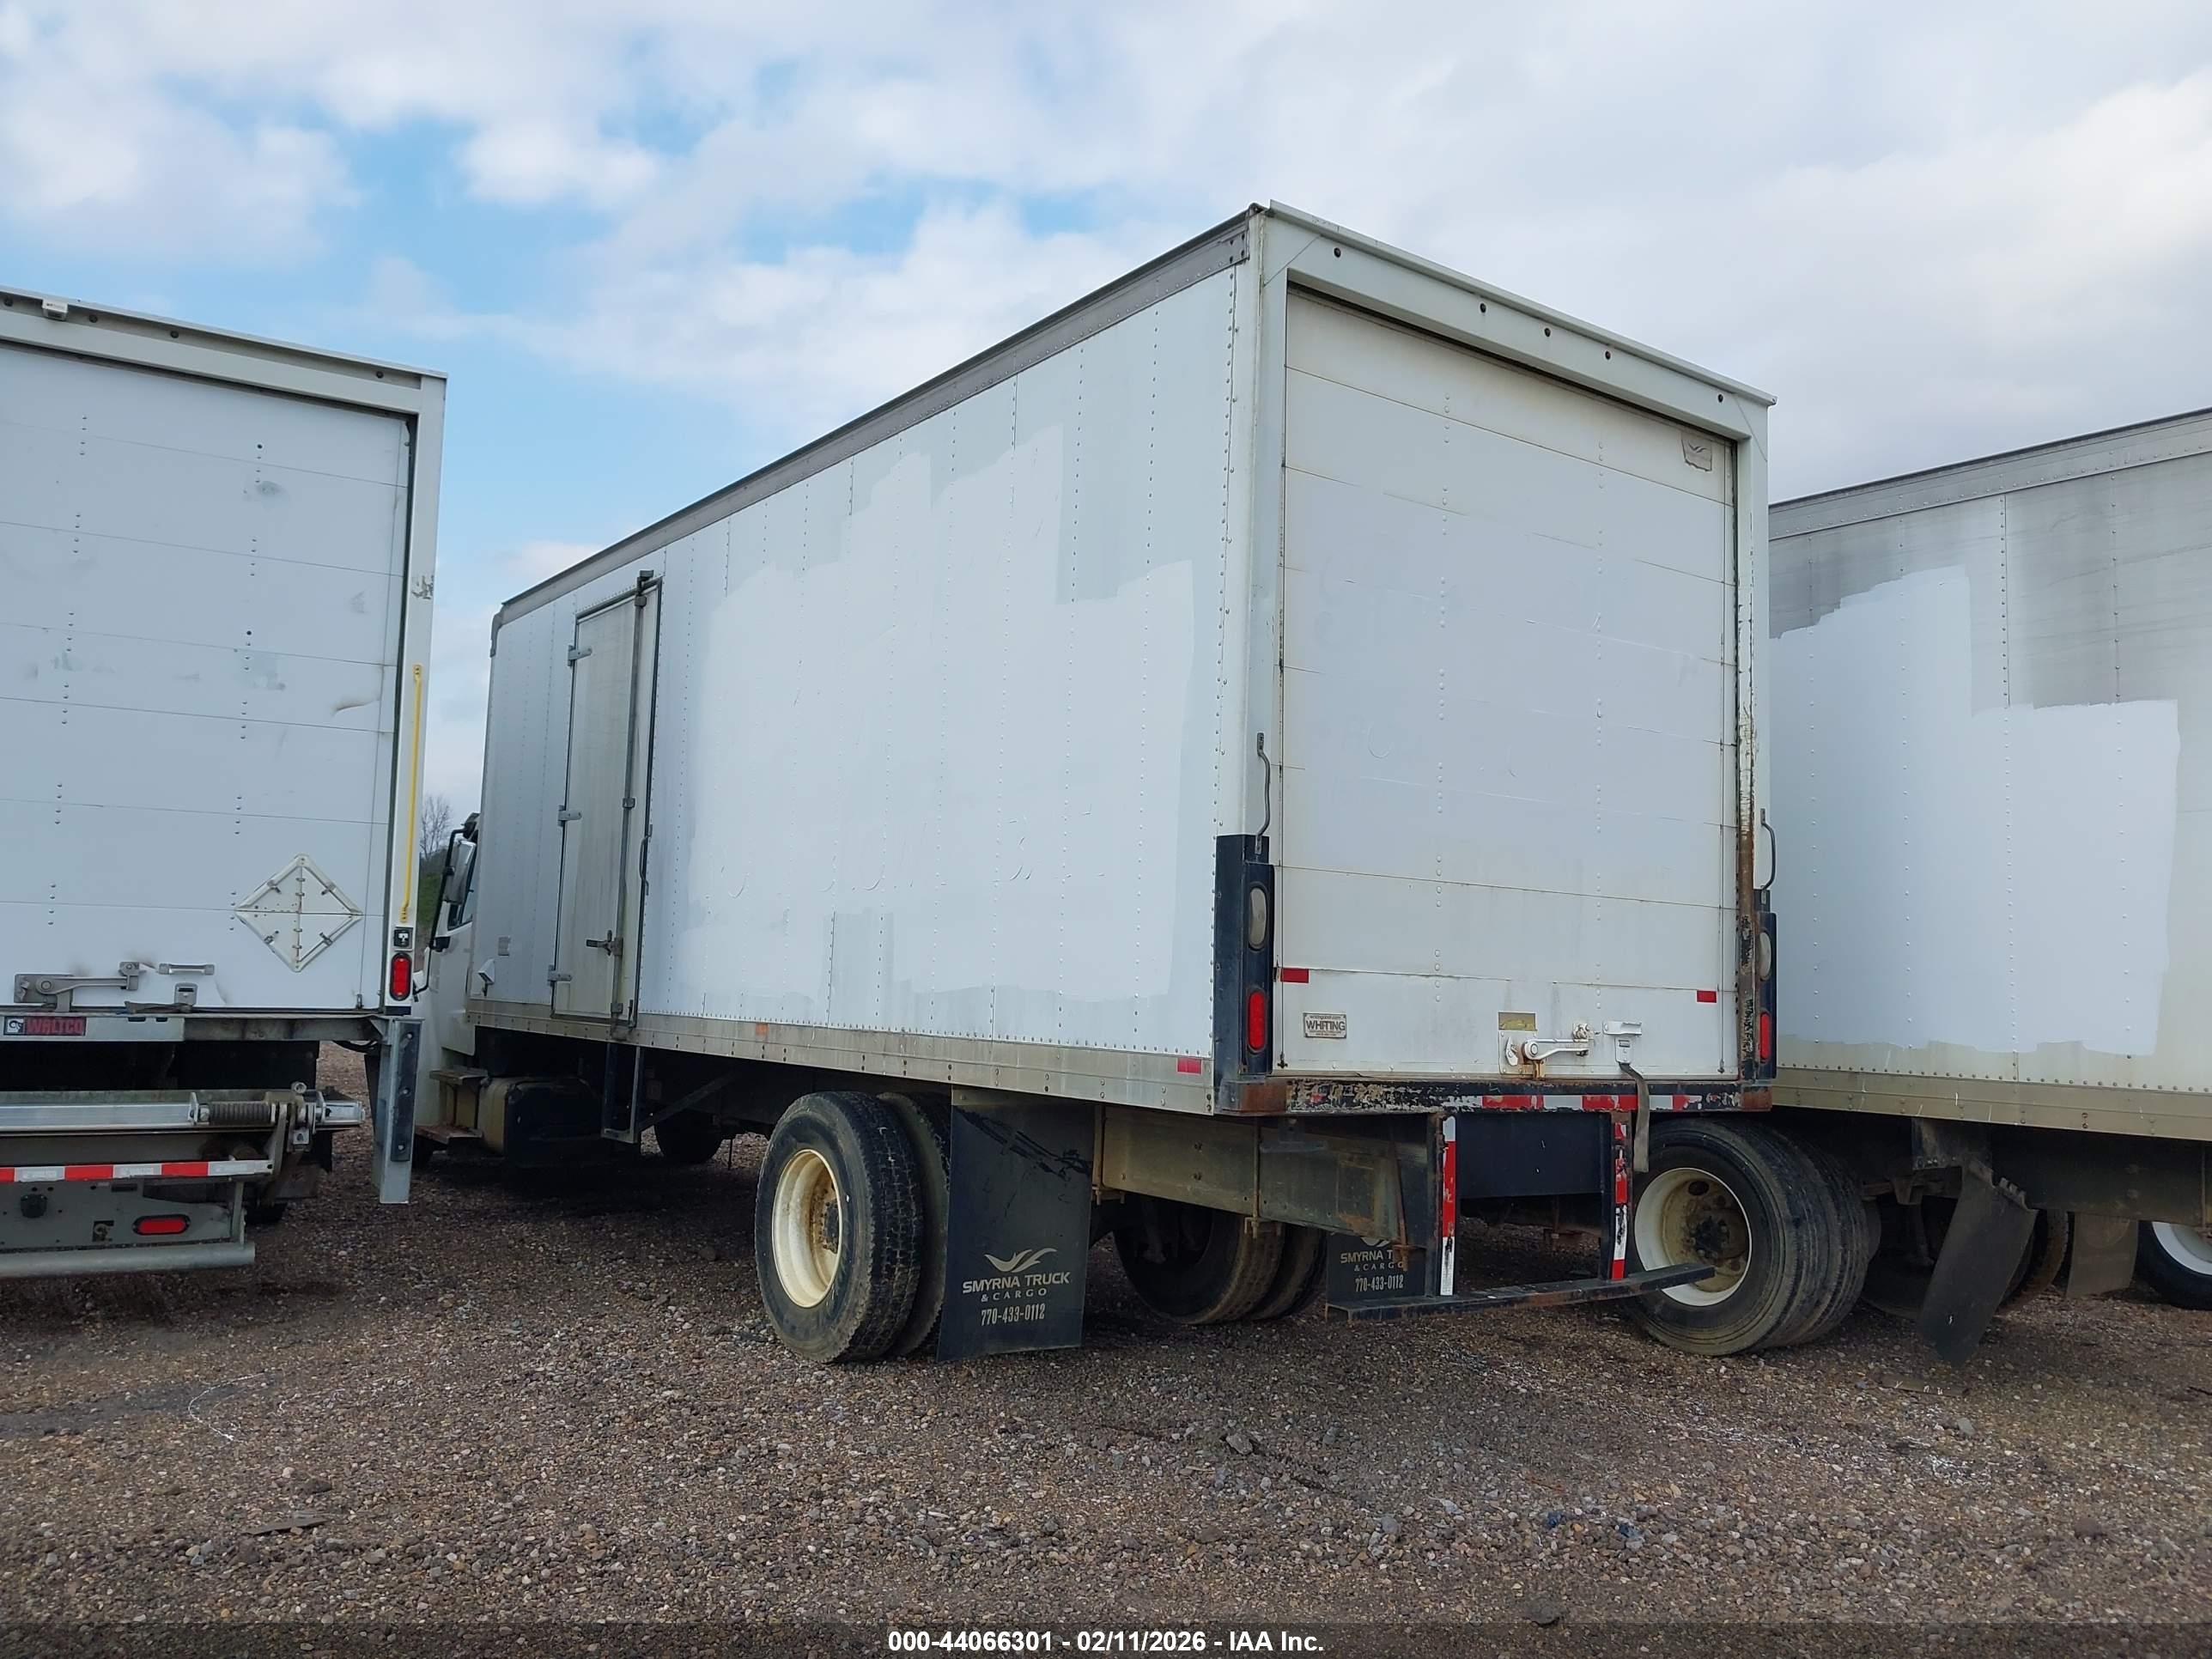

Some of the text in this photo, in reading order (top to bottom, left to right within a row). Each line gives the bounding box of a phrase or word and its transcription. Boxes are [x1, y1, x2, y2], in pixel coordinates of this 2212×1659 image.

[1306, 1020, 1346, 1031] WHITING
[1340, 1249, 1383, 1264] SMYRNA
[1363, 1261, 1404, 1271] CARGO
[963, 1272, 1071, 1294] SMYRNA TRUCK
[1355, 1274, 1404, 1292] 770-433-0112
[981, 1288, 1048, 1303] & CARGO
[981, 1303, 1045, 1326] 770-433-0112
